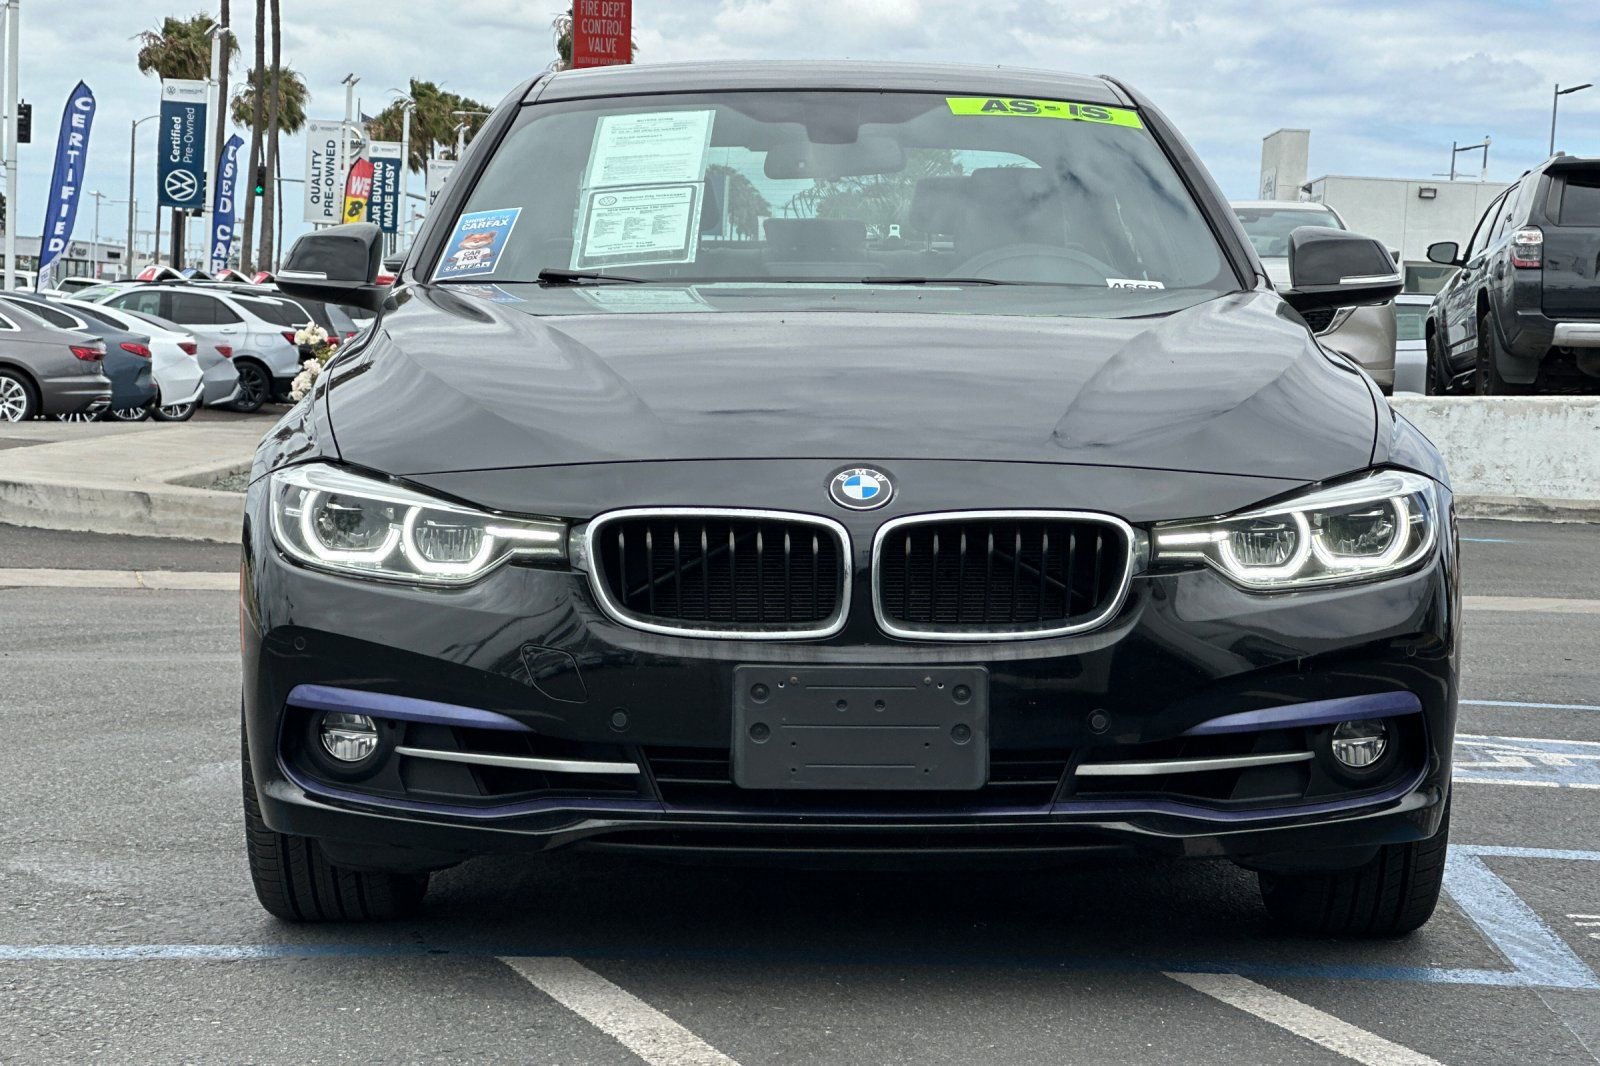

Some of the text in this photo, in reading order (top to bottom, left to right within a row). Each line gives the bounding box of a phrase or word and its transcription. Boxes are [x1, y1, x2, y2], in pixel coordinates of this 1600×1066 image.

[580, 0, 598, 16] FIRE
[581, 18, 624, 36] CONTROL
[588, 37, 617, 54] VALVE
[170, 116, 182, 163] Certified
[183, 107, 195, 164] Pre-Owned
[48, 97, 93, 253] CERTIFIED
[218, 145, 237, 214] USED
[310, 151, 322, 205] QUALITY
[324, 140, 336, 217] PRE-OWNED
[351, 175, 372, 197] WE
[372, 161, 383, 204] BUYING
[386, 163, 396, 193] EASY
[384, 194, 394, 228] MADE
[462, 219, 509, 231] CARFAX
